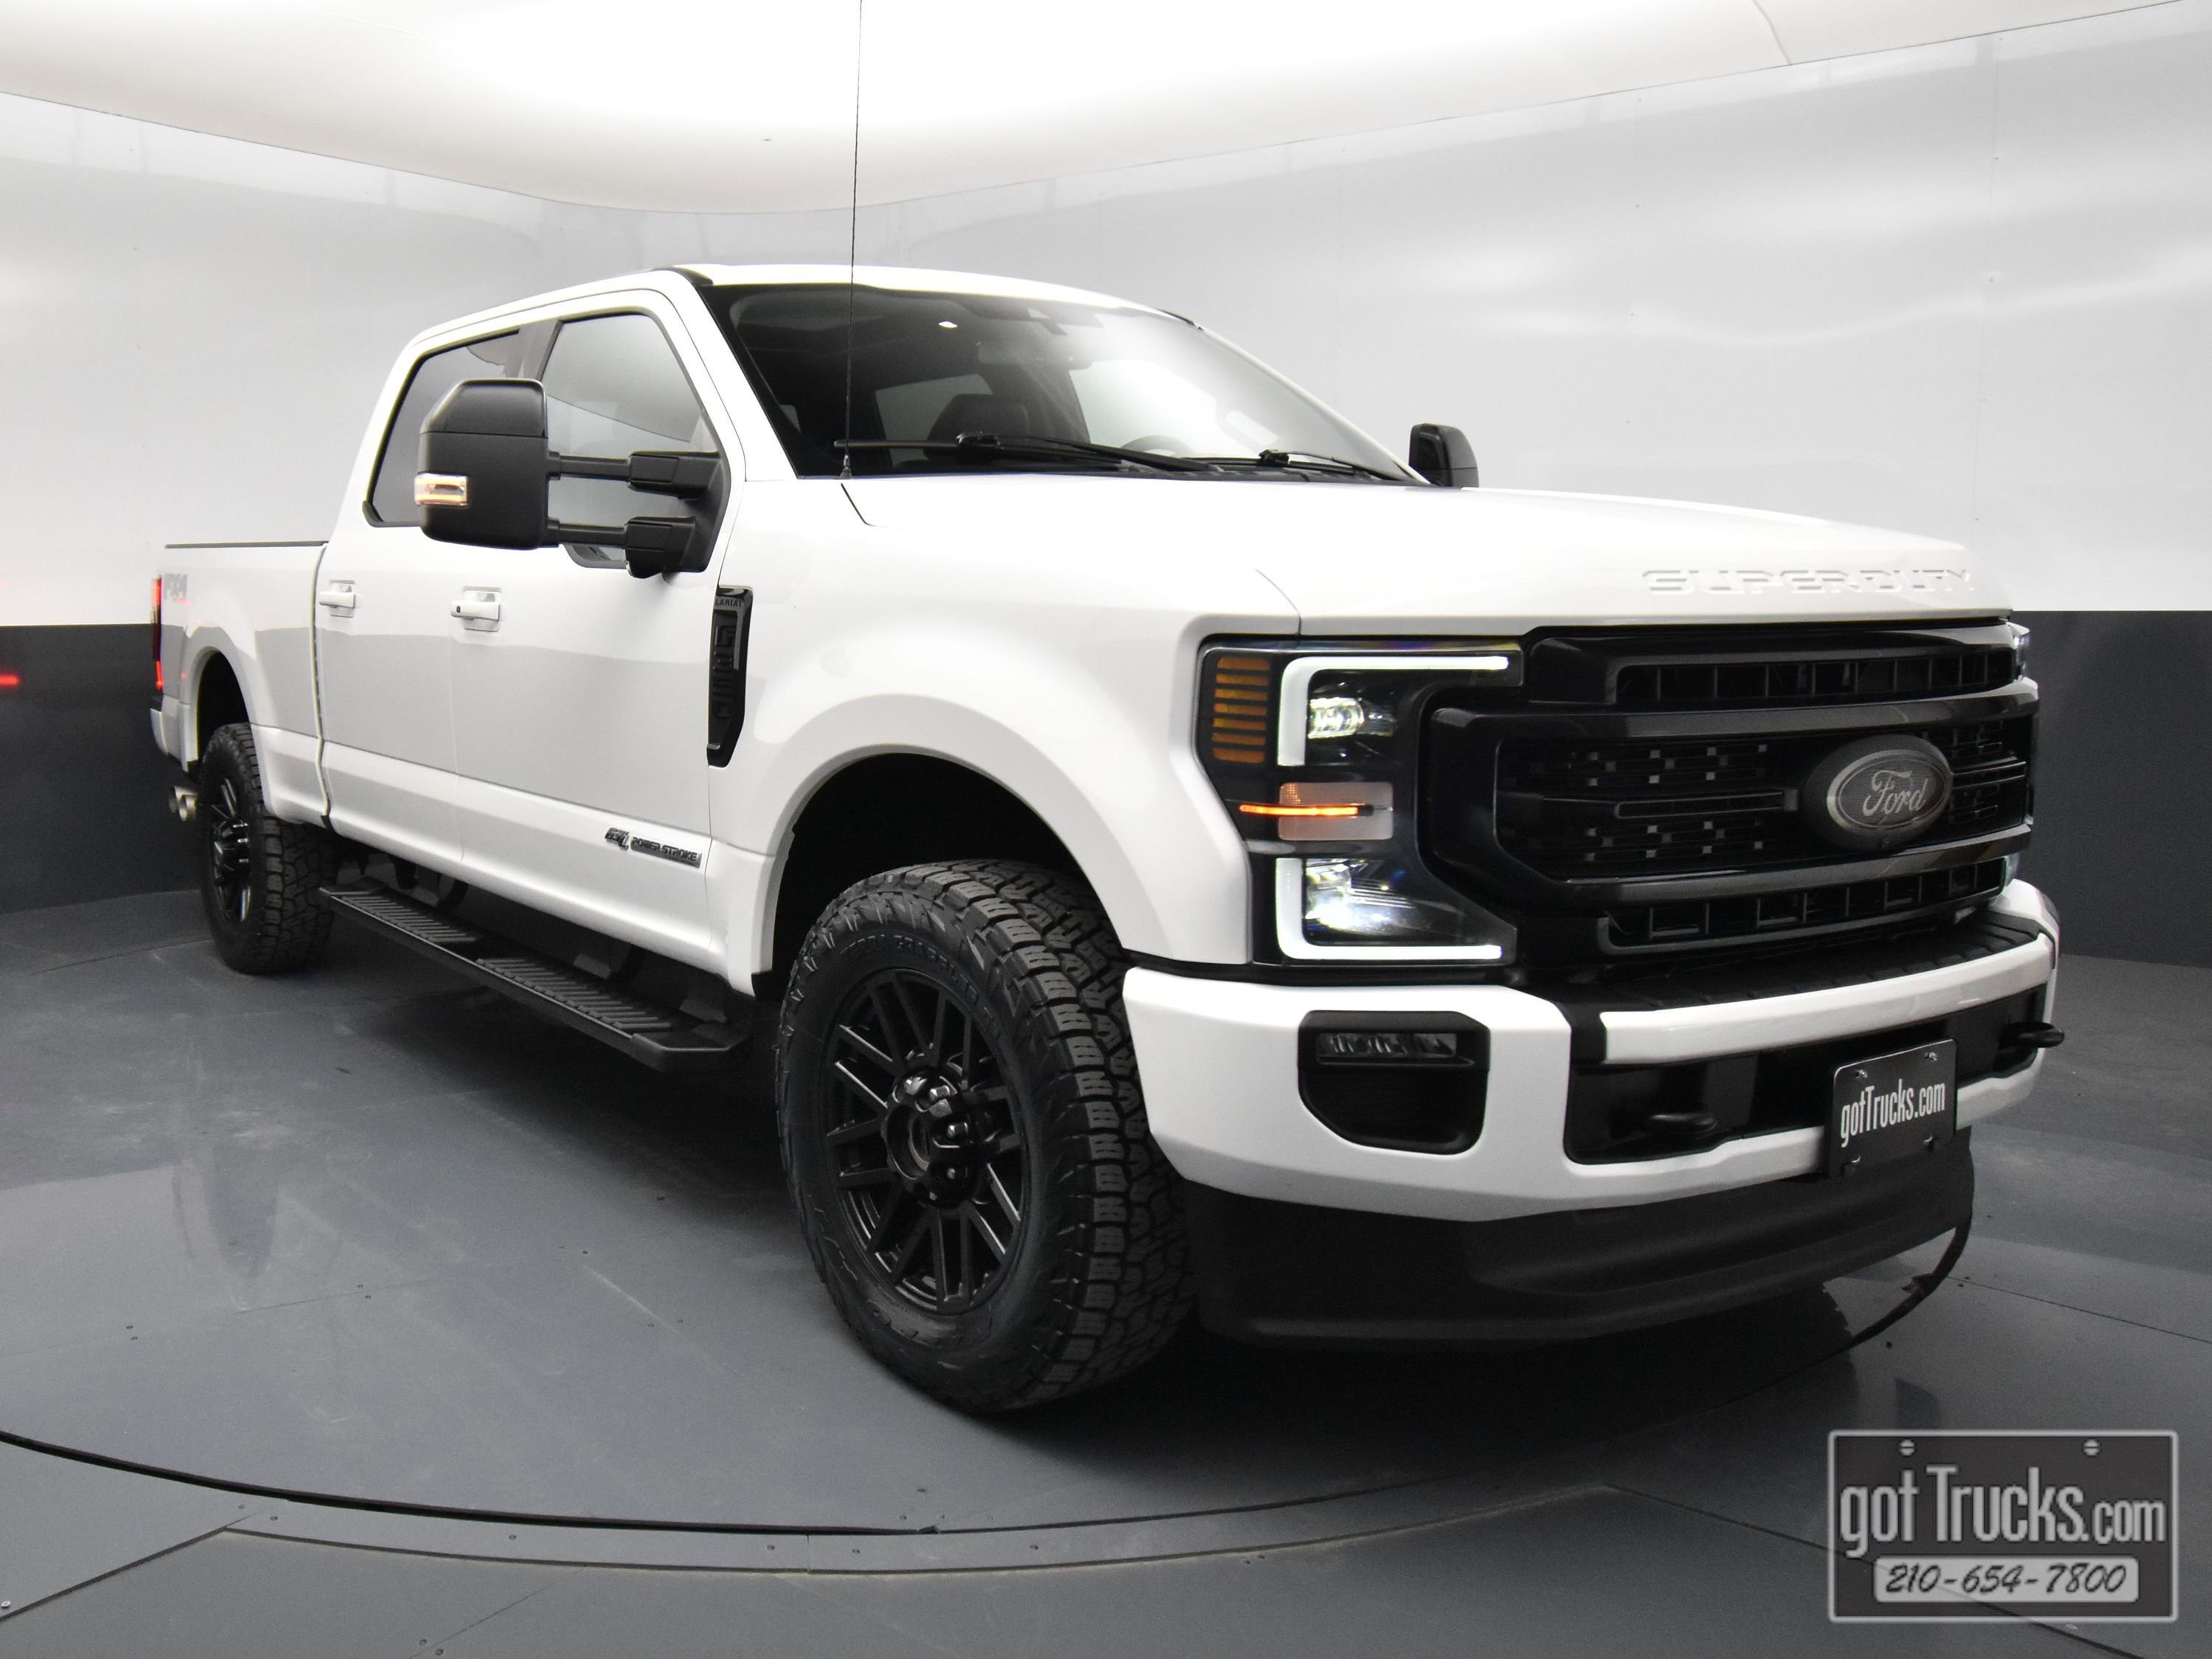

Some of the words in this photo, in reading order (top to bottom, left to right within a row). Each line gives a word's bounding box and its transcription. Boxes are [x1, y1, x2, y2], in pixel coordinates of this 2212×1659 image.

[1642, 569, 1863, 594] SUPER
[1859, 569, 1976, 592] DUTY
[714, 598, 742, 608] LARIAT
[1863, 769, 1930, 817] Ford
[661, 844, 698, 862] STROKE
[1840, 1078, 1946, 1148] gotTrucks.com
